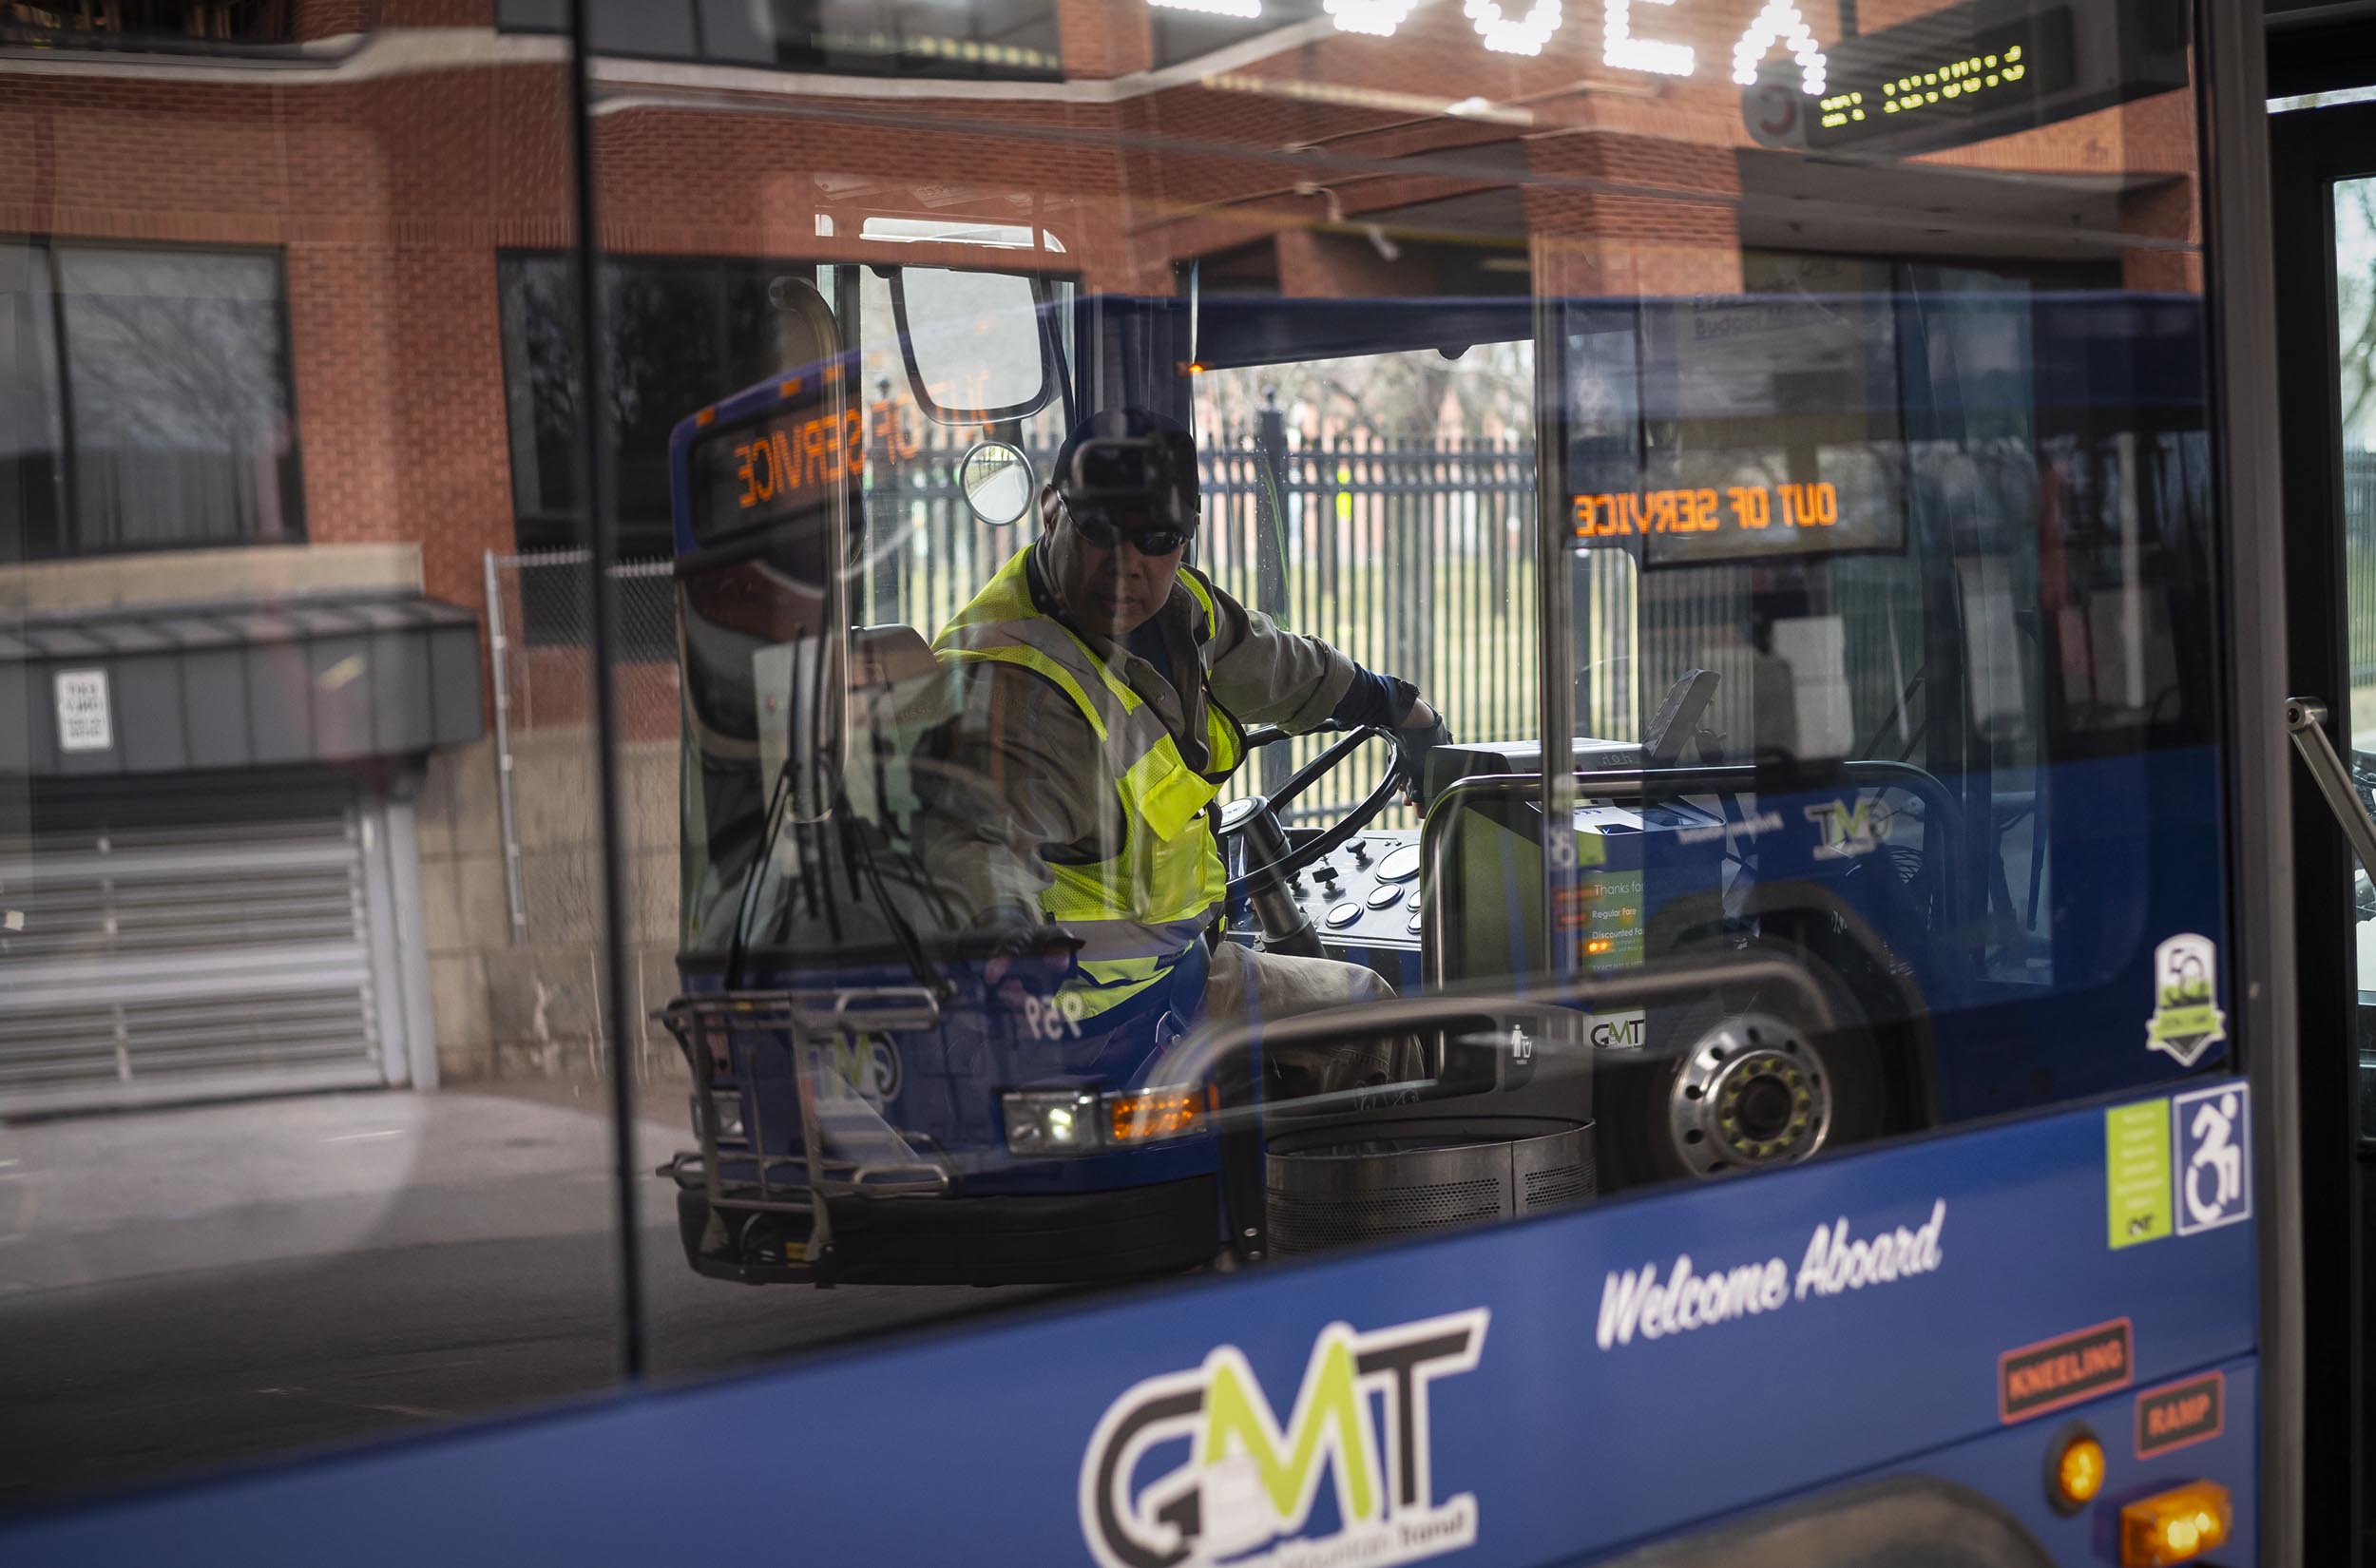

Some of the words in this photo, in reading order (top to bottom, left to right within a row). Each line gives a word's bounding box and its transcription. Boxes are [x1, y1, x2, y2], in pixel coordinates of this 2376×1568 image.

[1594, 882, 1629, 896] Thanks
[1592, 908, 1620, 920] Regular
[1621, 907, 1637, 916] Fare
[1592, 927, 1633, 939] Discounted
[1590, 1019, 1645, 1049] GMT
[1596, 1252, 1790, 1351] Welcome
[1794, 1197, 1945, 1301] Aboard
[2008, 1338, 2122, 1401] KNEELING
[2147, 1392, 2211, 1437] RAMP
[1087, 1319, 1483, 1568] GMT
